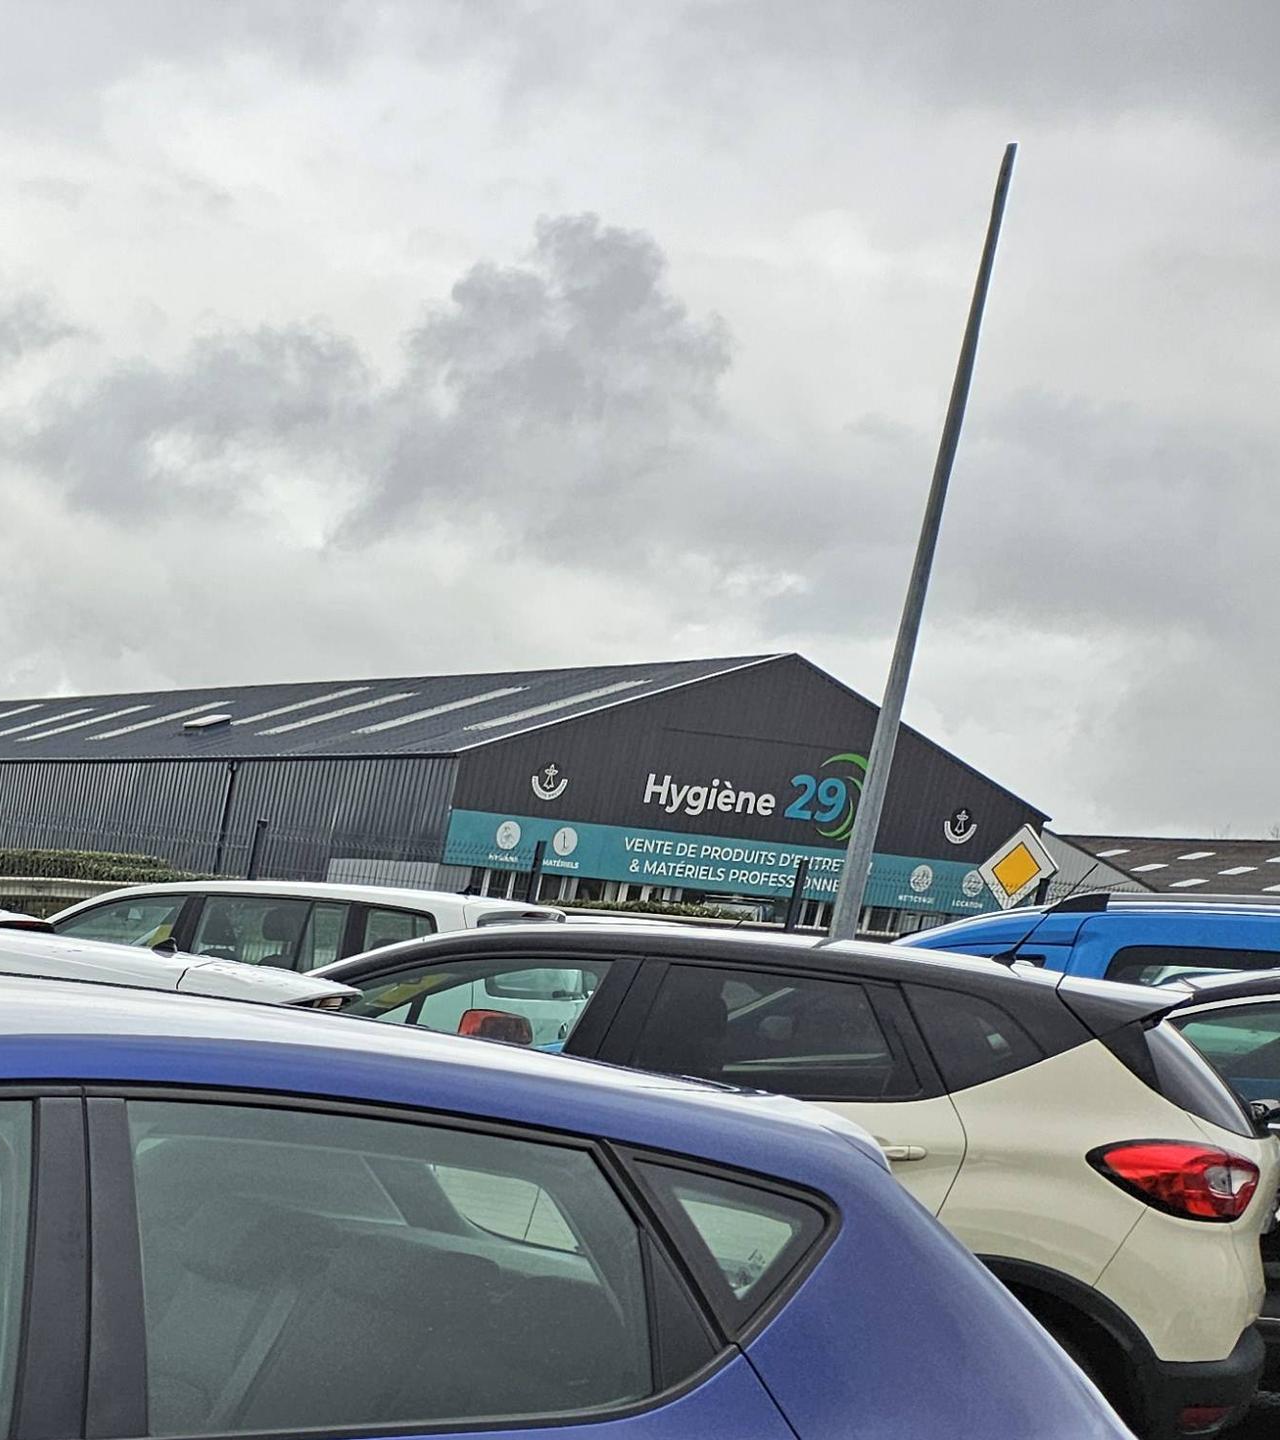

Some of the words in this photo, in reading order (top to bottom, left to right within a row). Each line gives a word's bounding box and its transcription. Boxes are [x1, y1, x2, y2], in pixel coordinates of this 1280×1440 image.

[643, 773, 776, 816] Hygiène
[784, 774, 848, 822] 29
[624, 836, 674, 855] VENTE
[676, 842, 697, 857] DE
[700, 845, 776, 866] PRODUITS
[629, 858, 640, 873] &
[643, 860, 726, 882] MATÉRIELS
